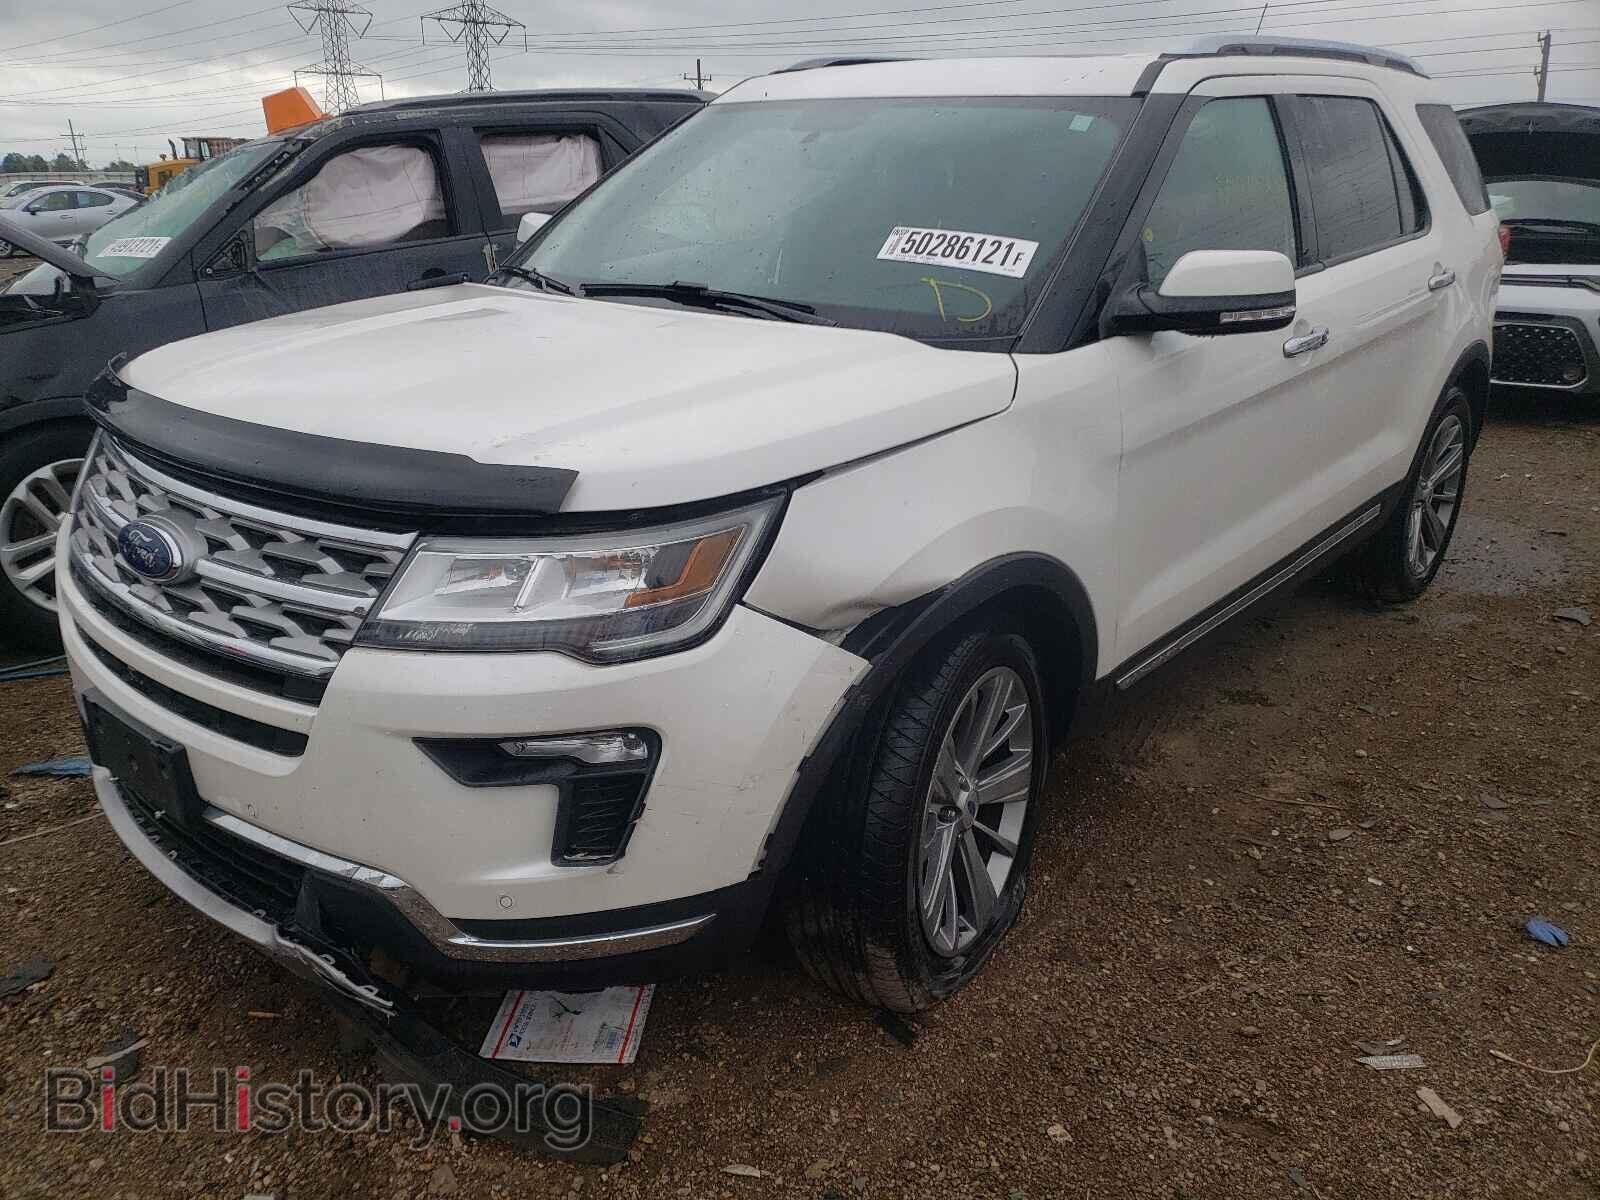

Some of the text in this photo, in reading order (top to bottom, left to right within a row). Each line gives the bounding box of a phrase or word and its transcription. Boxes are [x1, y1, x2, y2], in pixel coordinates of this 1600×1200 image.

[901, 231, 1015, 266] 50286121
[1012, 252, 1025, 266] F
[128, 529, 159, 568] Ford
